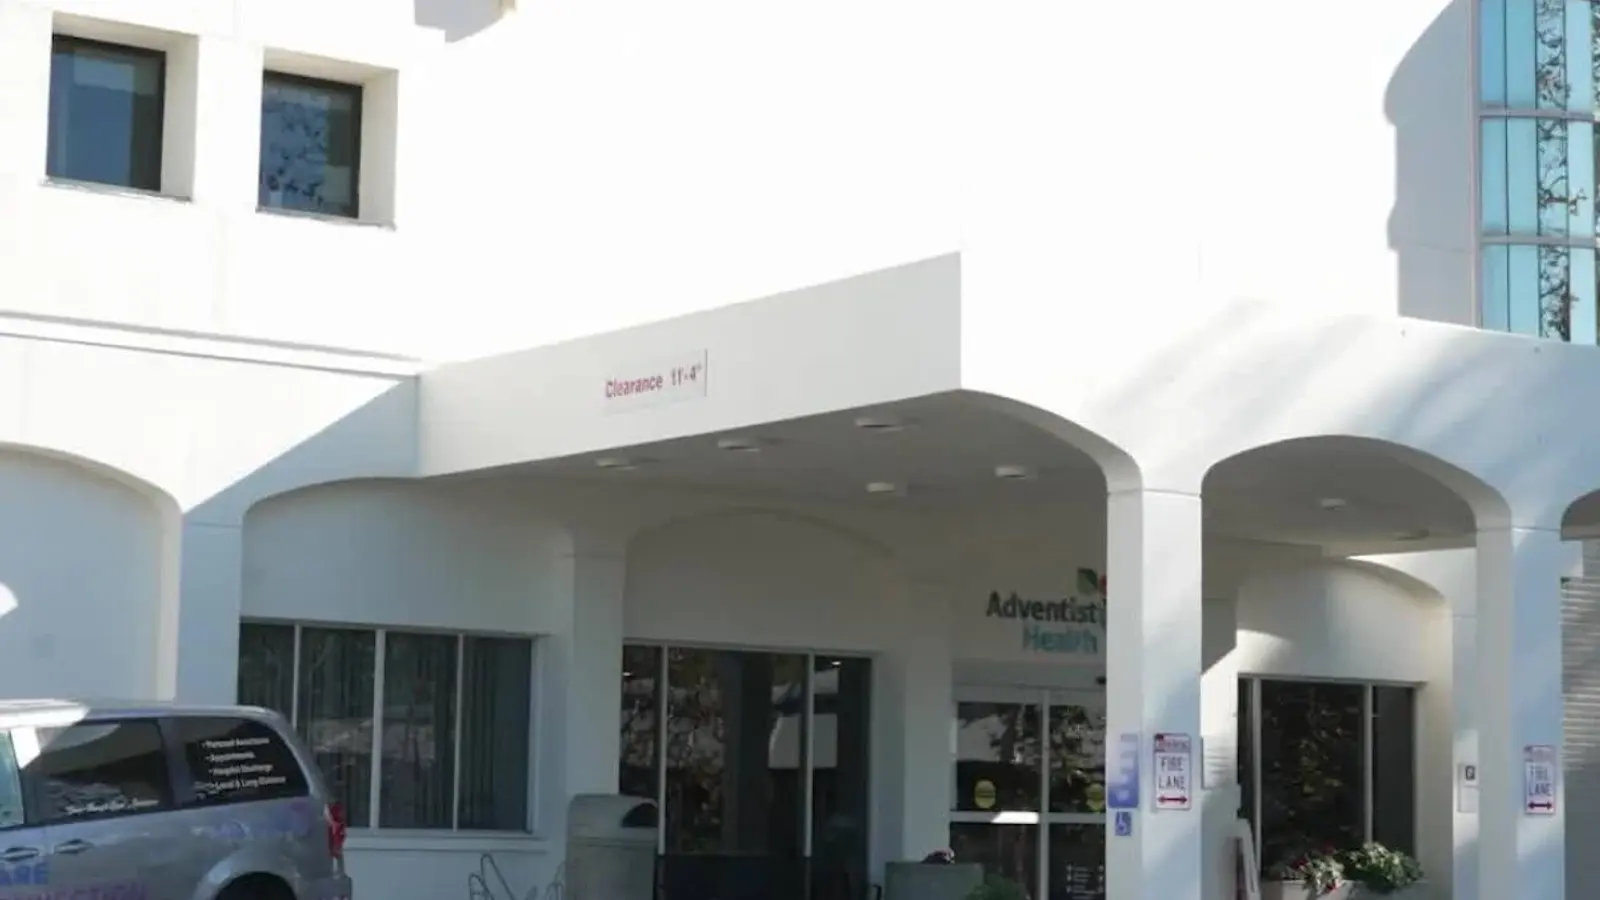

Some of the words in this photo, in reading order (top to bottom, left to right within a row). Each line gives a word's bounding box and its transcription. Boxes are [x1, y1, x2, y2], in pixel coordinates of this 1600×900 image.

[606, 375, 663, 399] Clearance
[986, 590, 1098, 624] Adventist
[1023, 624, 1098, 655] Health
[1158, 776, 1186, 789] LANE
